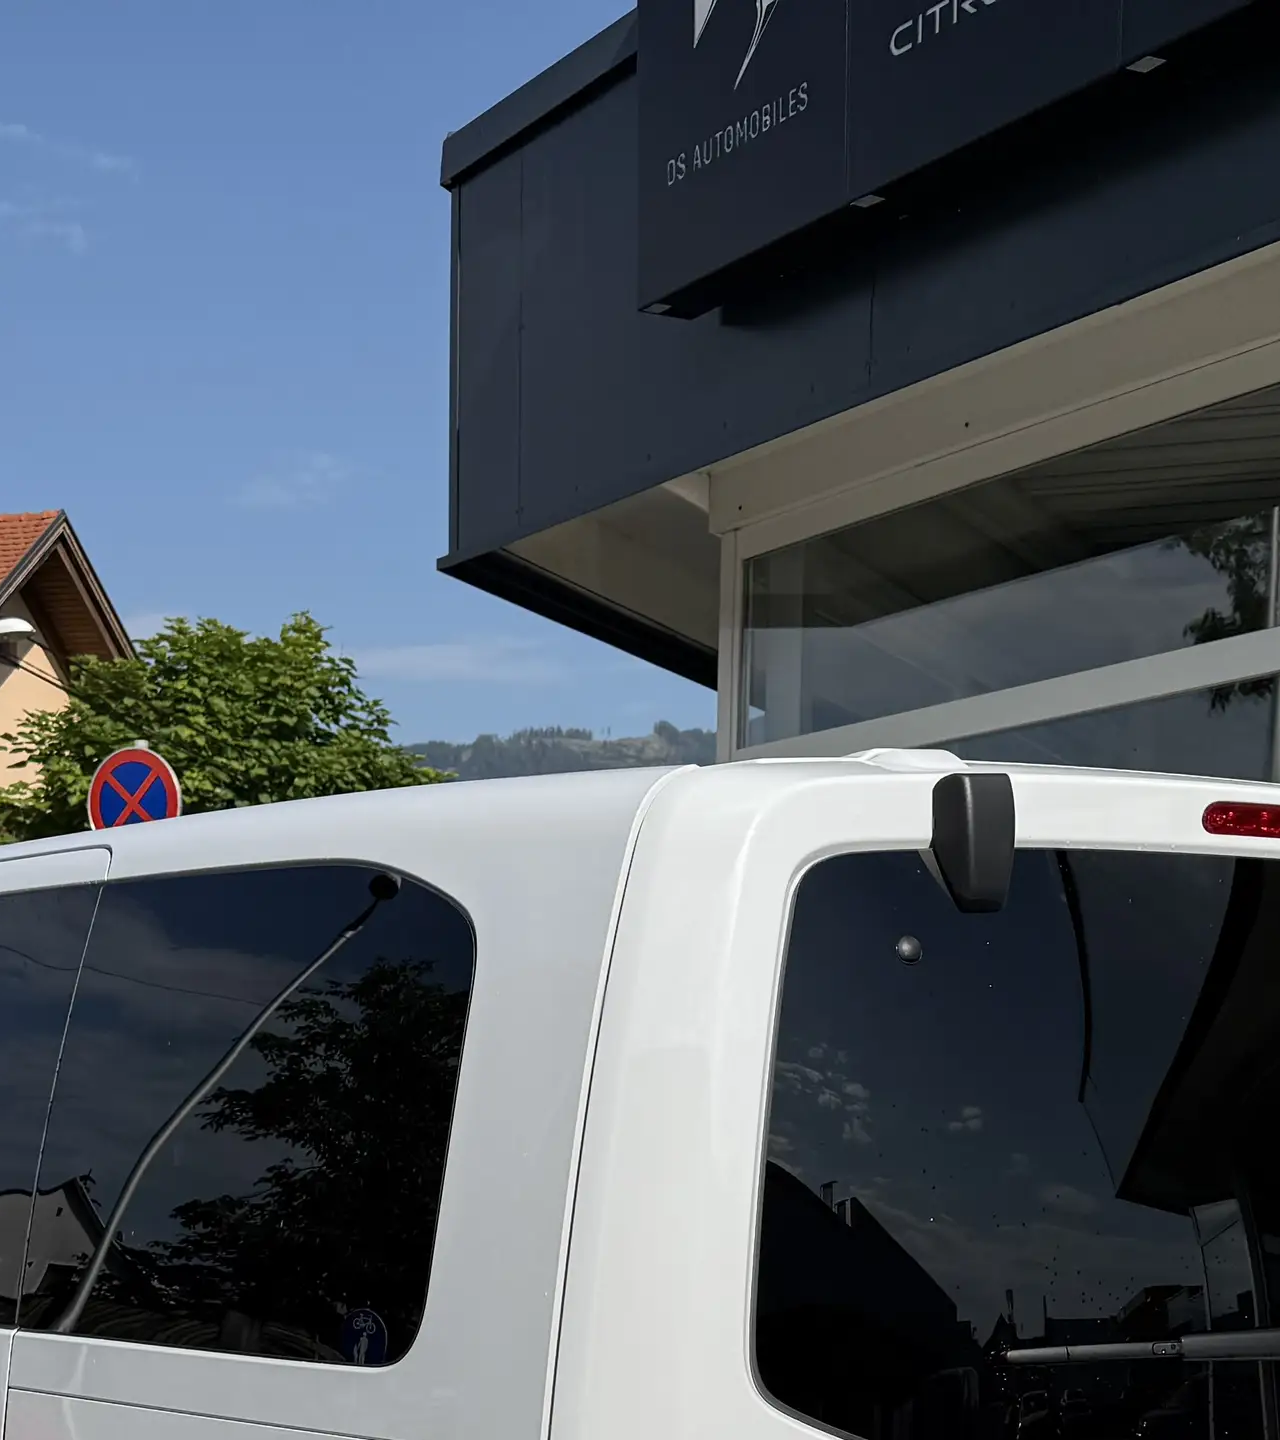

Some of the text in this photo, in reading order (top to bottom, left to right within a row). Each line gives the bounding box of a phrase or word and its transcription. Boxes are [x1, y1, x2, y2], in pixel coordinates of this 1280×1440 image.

[889, 0, 996, 56] CITR
[667, 81, 809, 186] DS AUTOMOBILES
